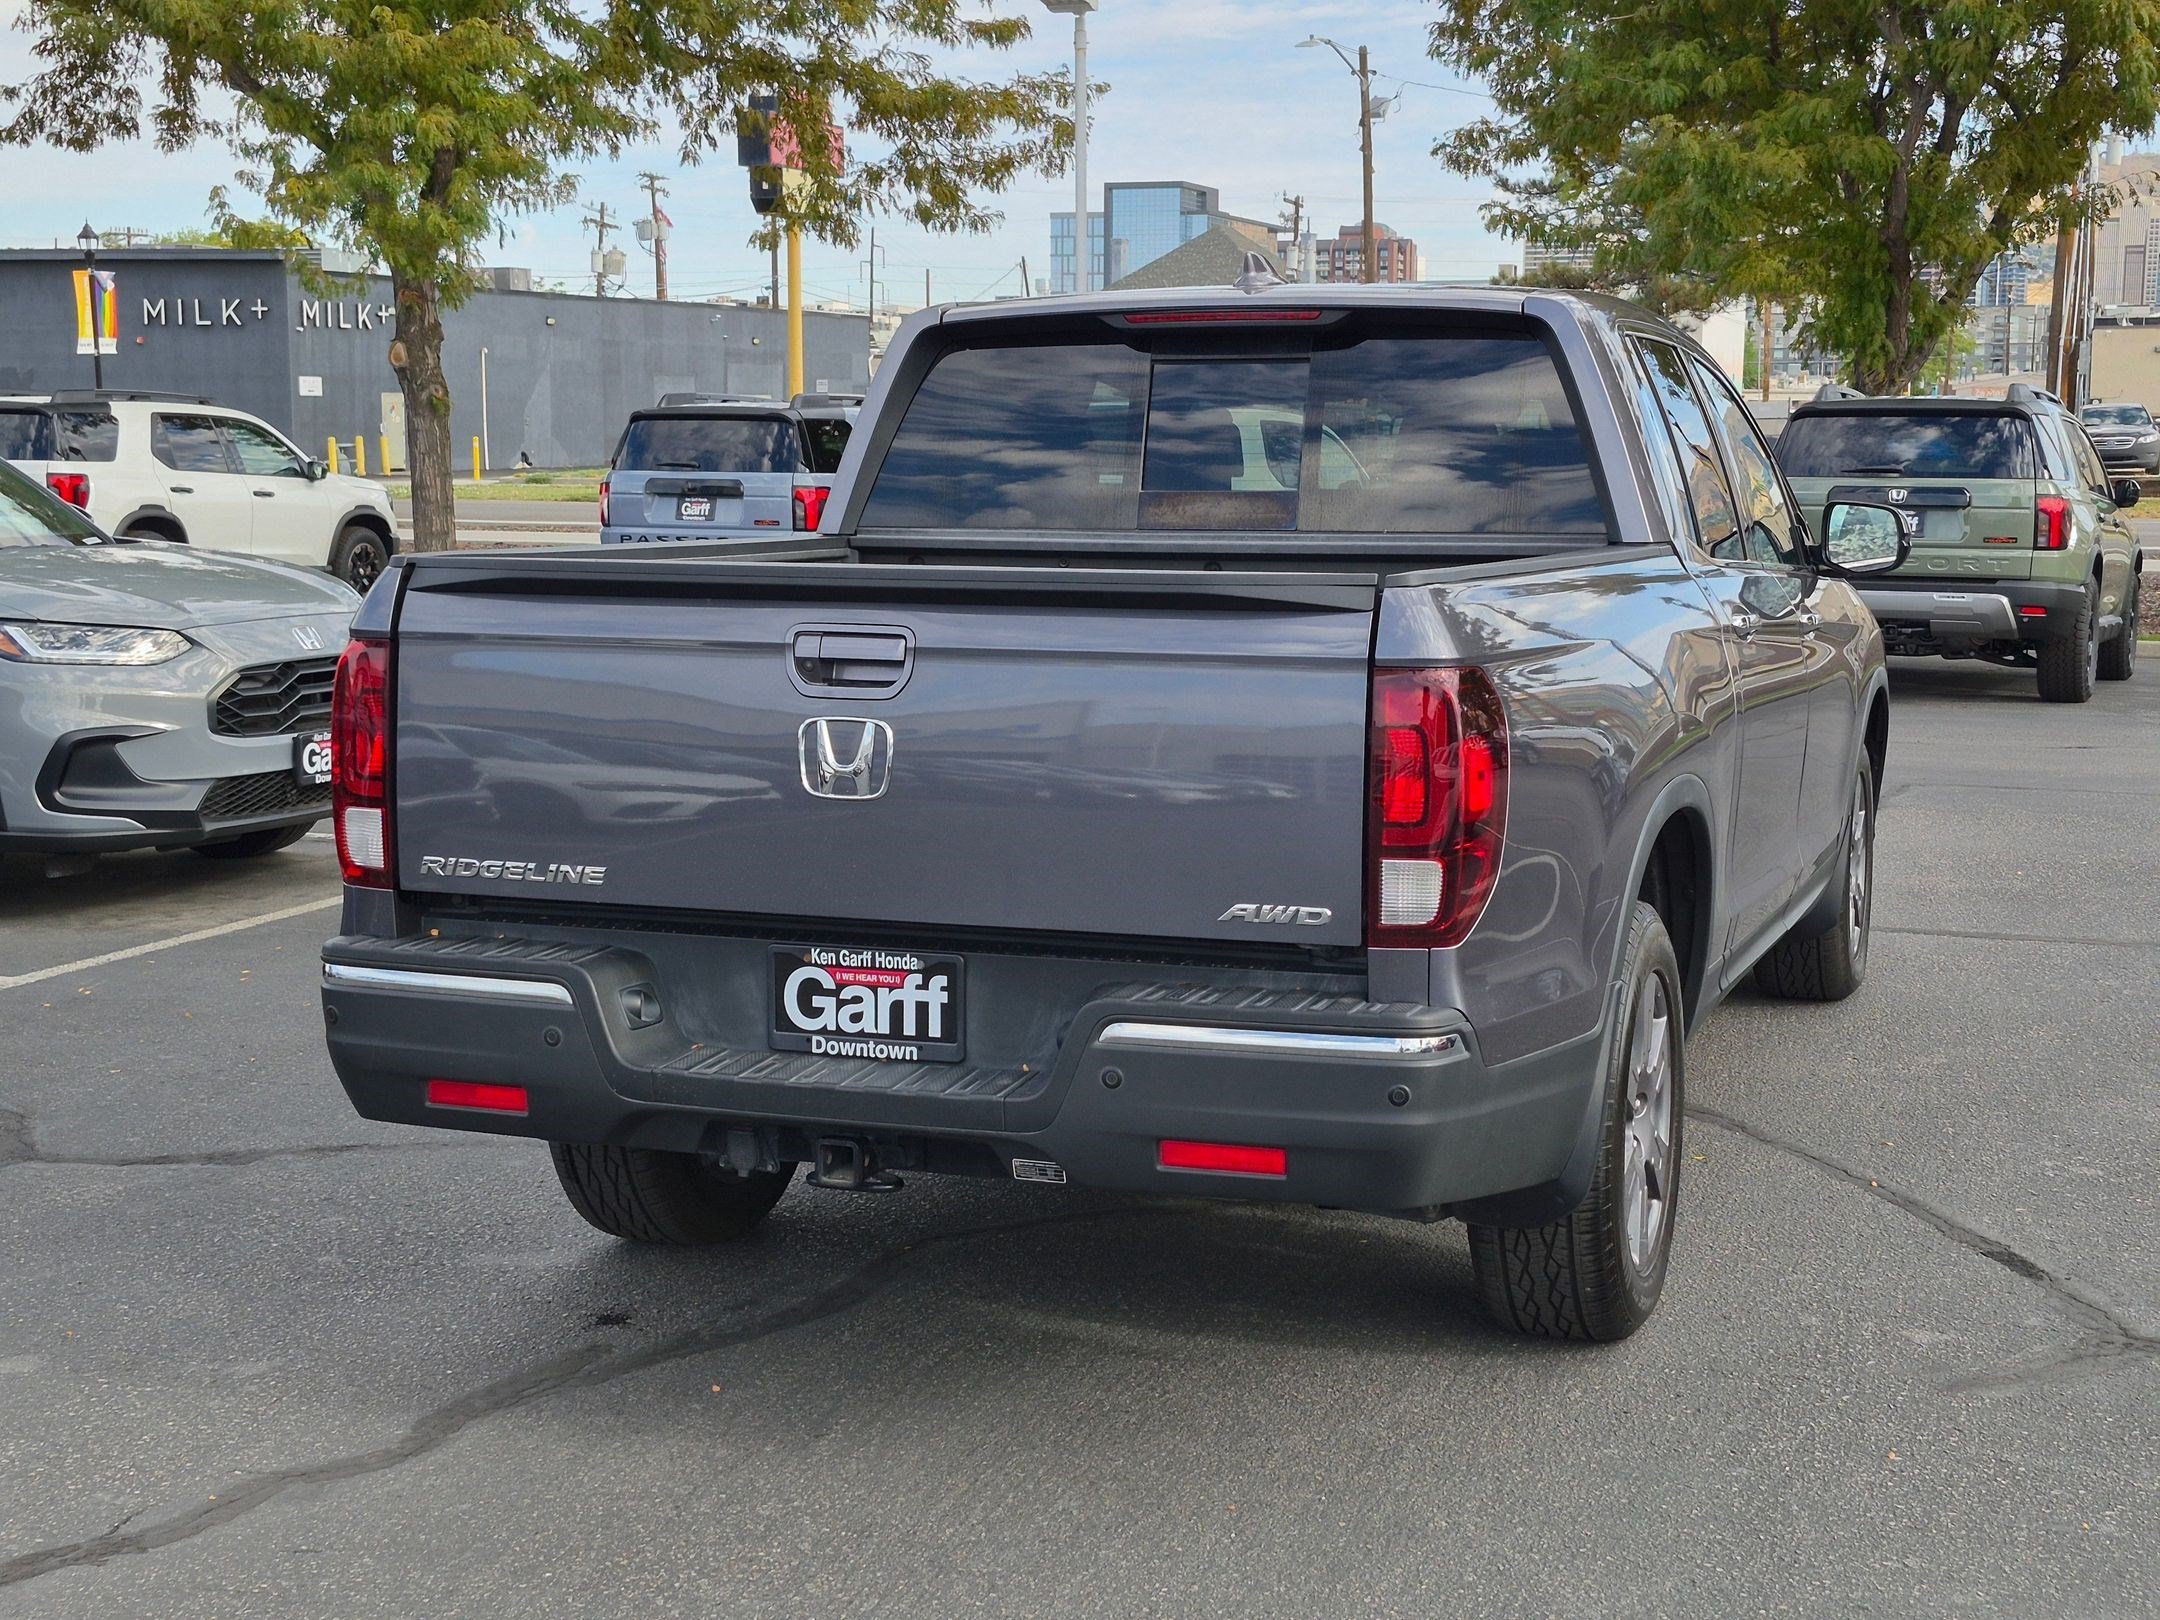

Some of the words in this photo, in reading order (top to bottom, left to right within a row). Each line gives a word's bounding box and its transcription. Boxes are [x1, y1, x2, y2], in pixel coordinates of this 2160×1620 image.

[143, 298, 269, 326] MILK+
[301, 299, 390, 330] MILK+
[681, 502, 711, 516] Garff
[1900, 556, 2010, 572] PORT
[419, 855, 608, 886] RIDGELINE
[1217, 903, 1332, 926] AWD
[810, 948, 836, 966] Ken
[839, 950, 872, 968] Garff
[875, 952, 918, 970] Honda
[841, 972, 855, 981] WE
[855, 973, 878, 982] HEAR
[878, 975, 895, 983] YOU
[783, 966, 949, 1038] Garff
[811, 1036, 918, 1061] Downtown
